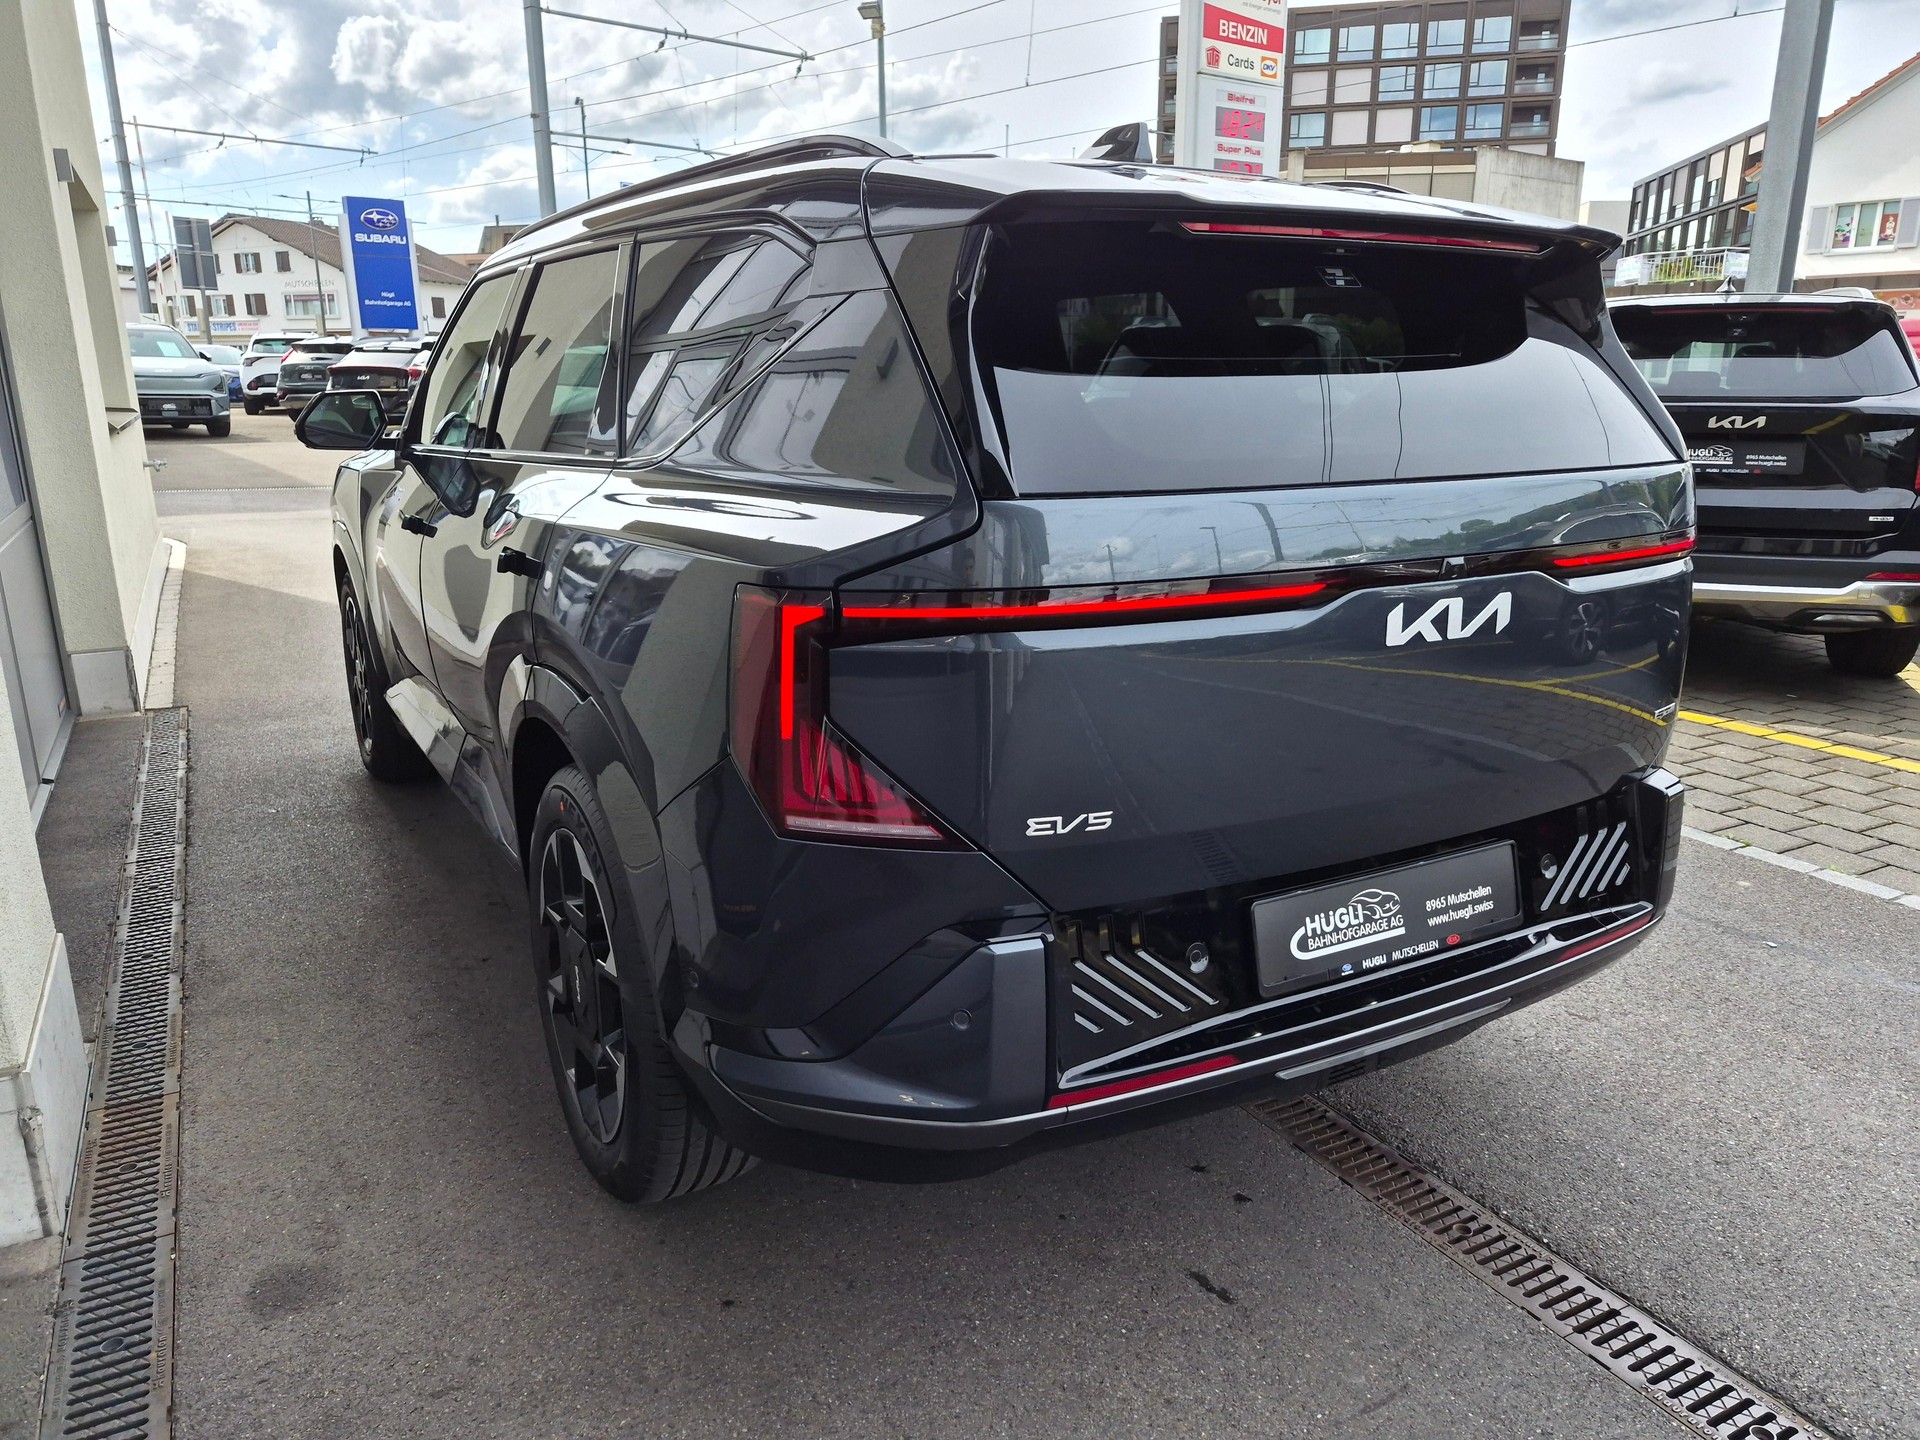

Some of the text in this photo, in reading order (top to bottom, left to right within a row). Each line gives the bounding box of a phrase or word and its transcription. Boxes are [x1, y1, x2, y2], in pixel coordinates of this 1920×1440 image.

[1219, 19, 1268, 46] BENZIN
[1227, 53, 1255, 70] Cards
[1262, 63, 1276, 72] DKV
[1227, 90, 1256, 105] Bleifrei
[1217, 143, 1261, 156] Super Plus
[354, 233, 407, 245] SUBARU
[284, 279, 335, 288] MUTSCHELEN
[212, 322, 237, 332] STRIPES
[1025, 811, 1114, 837] EV5
[1425, 885, 1492, 912] 8965 Mutschellen
[1305, 903, 1364, 937] HÜGLI
[1427, 900, 1494, 927] www.huegli.swiss
[1307, 914, 1404, 950] BAHNHOFGARAGE AG
[1362, 939, 1439, 969] HUGLI MUTSCHELLEN
